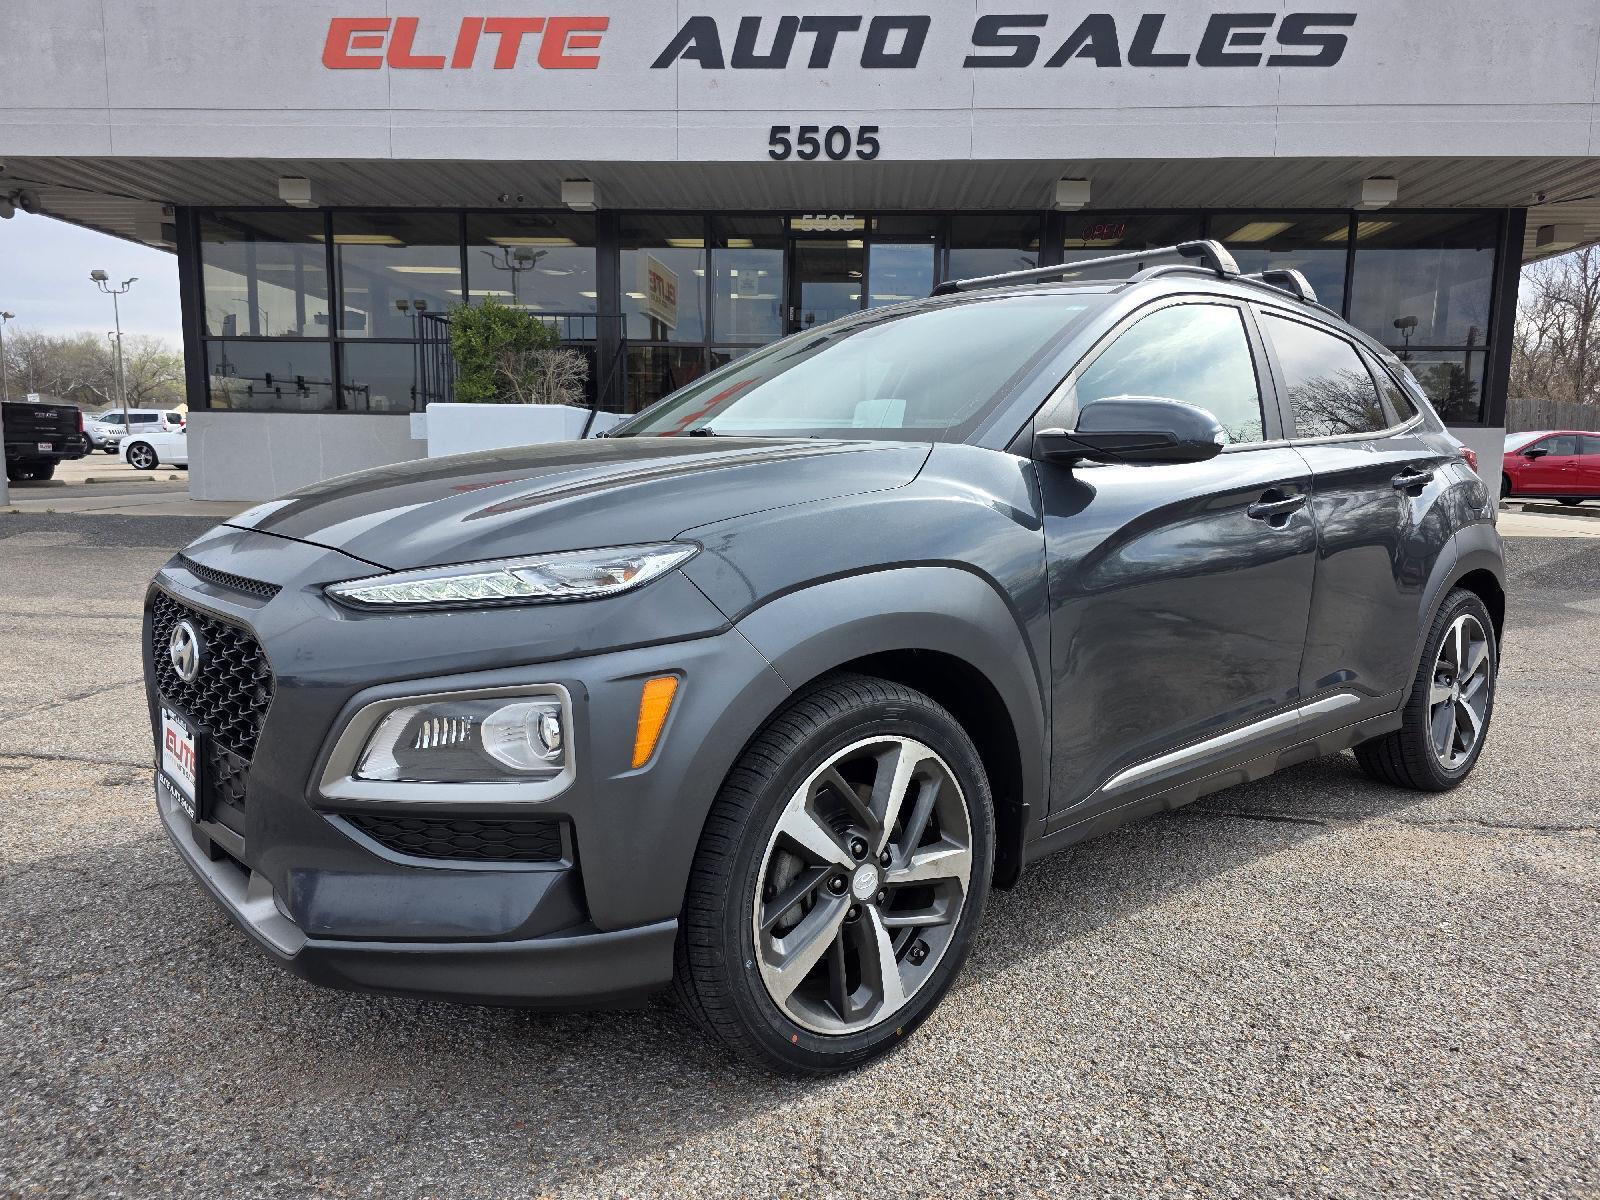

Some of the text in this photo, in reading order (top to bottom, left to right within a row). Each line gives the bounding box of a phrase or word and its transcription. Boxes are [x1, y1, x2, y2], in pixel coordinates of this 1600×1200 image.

[322, 13, 1357, 70] ELITE AUTO SALES
[768, 125, 881, 161] 5505
[801, 214, 855, 231] 5505
[1082, 223, 1127, 241] OPEN
